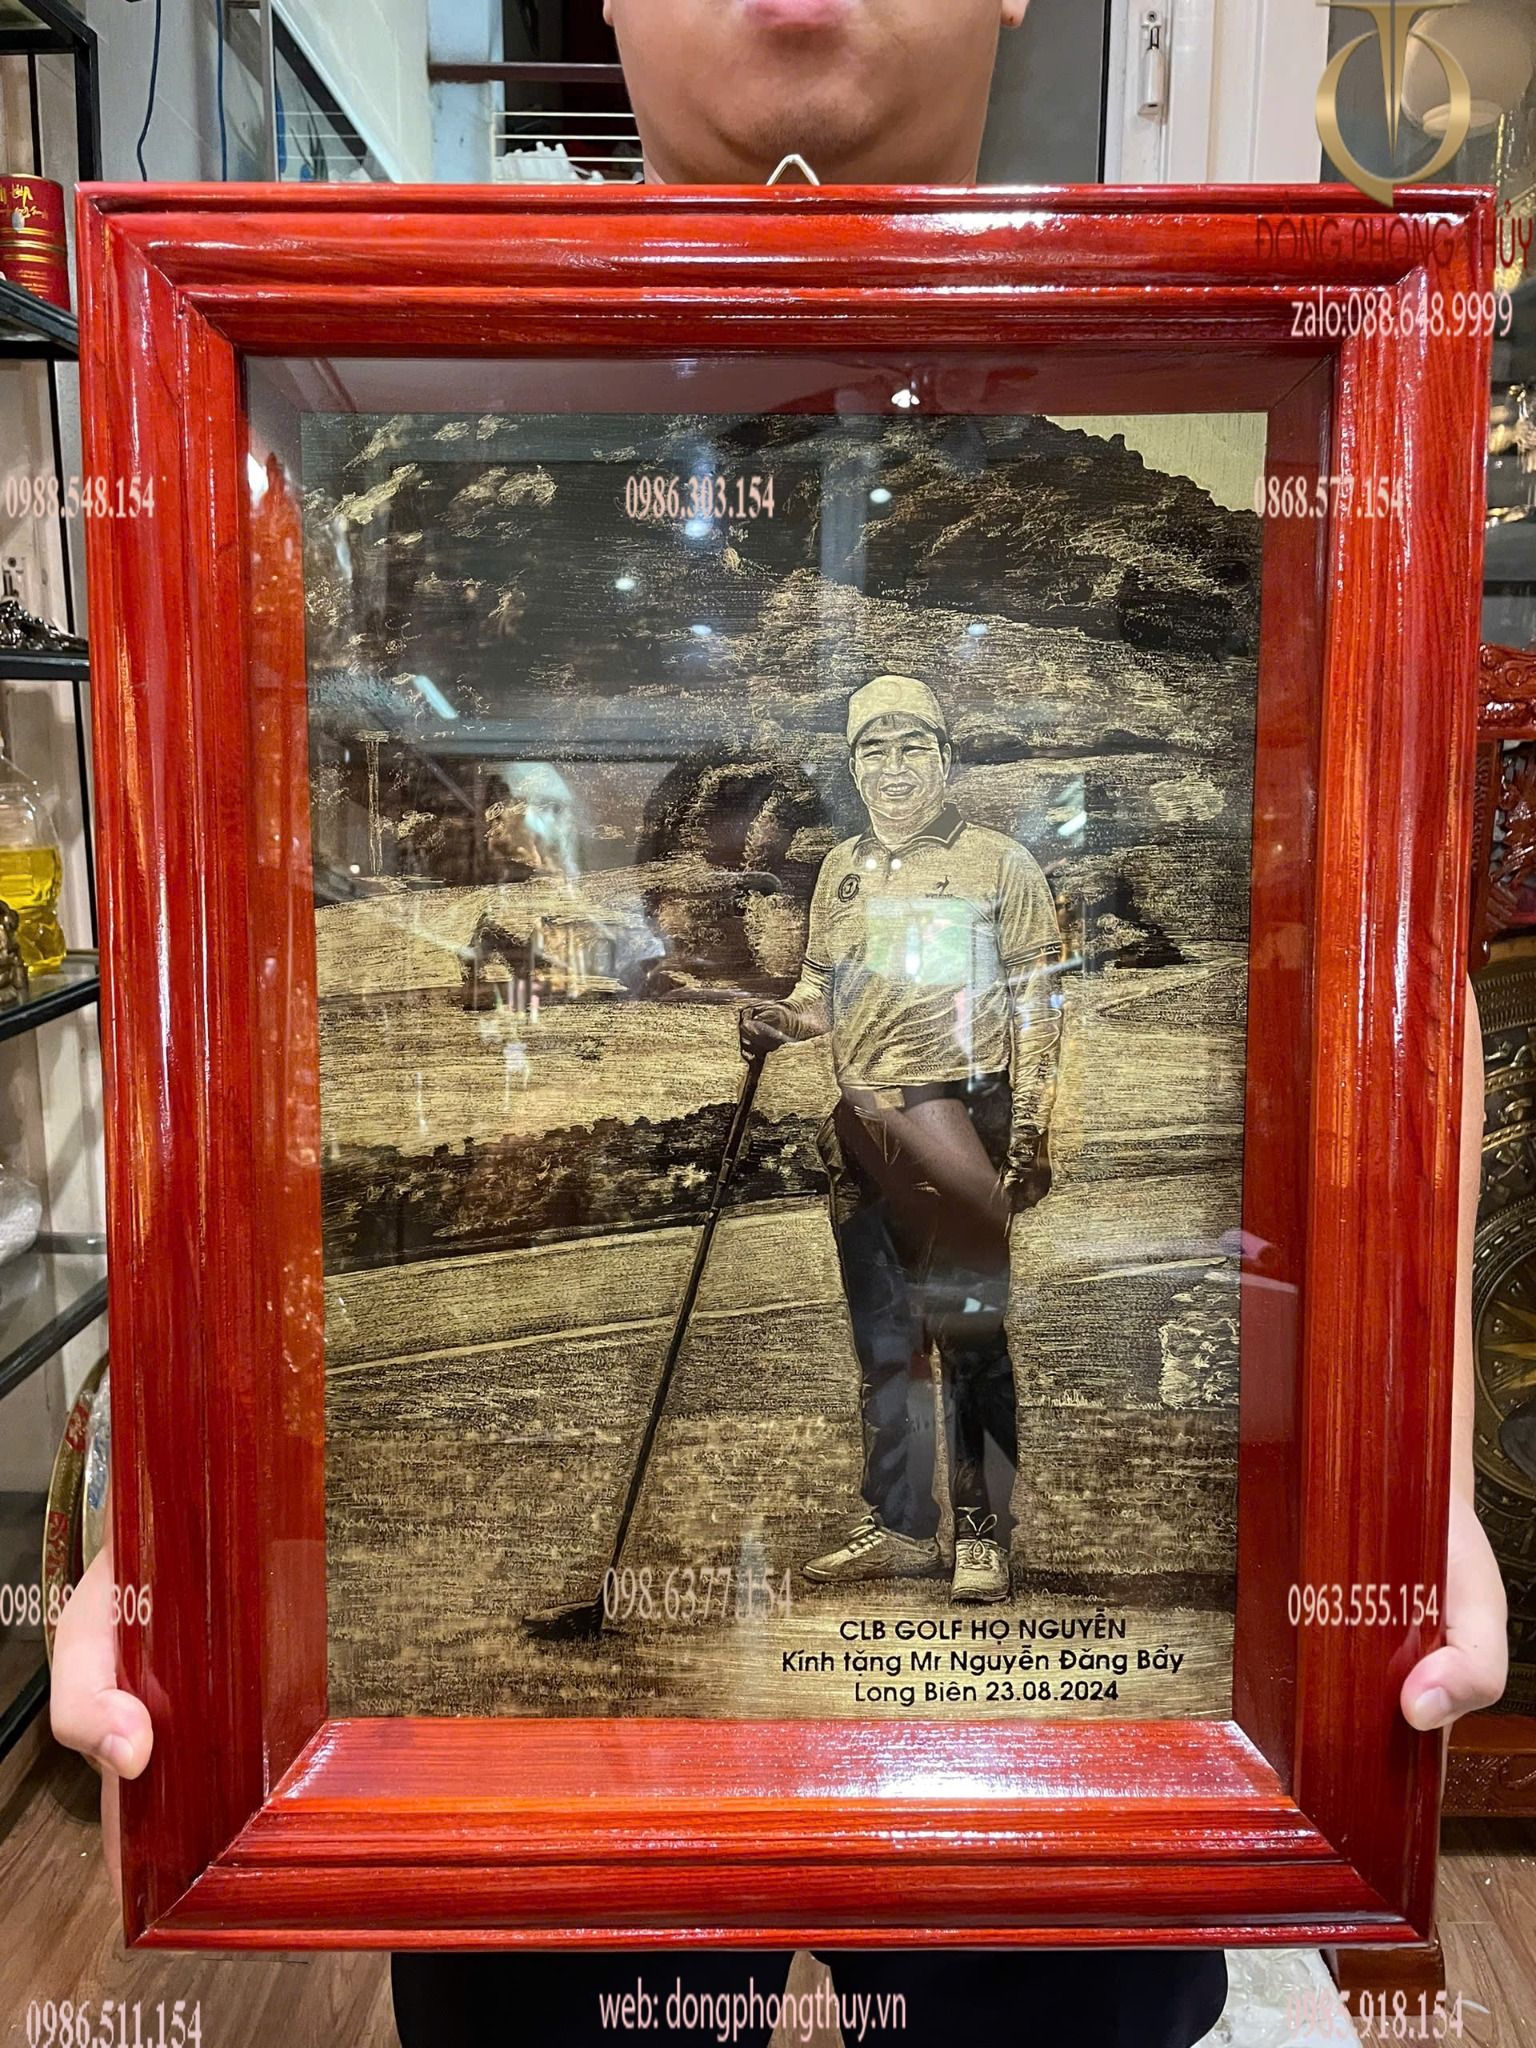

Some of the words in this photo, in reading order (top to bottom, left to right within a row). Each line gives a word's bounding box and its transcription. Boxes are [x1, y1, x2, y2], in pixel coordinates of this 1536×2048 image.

[839, 1619, 886, 1642] CLB
[894, 1618, 963, 1642] GOLF
[971, 1618, 1010, 1645] HỌ
[1018, 1607, 1126, 1641] NGUYỄN
[781, 1649, 835, 1672] Kính
[843, 1649, 901, 1677] tặng
[910, 1651, 943, 1672] Mr
[950, 1645, 1050, 1676] Nguyễn
[1058, 1649, 1128, 1675] Đăng
[855, 1682, 916, 1707] Long
[924, 1680, 977, 1702] Biên
[985, 1680, 1119, 1701] 23.08.2024
